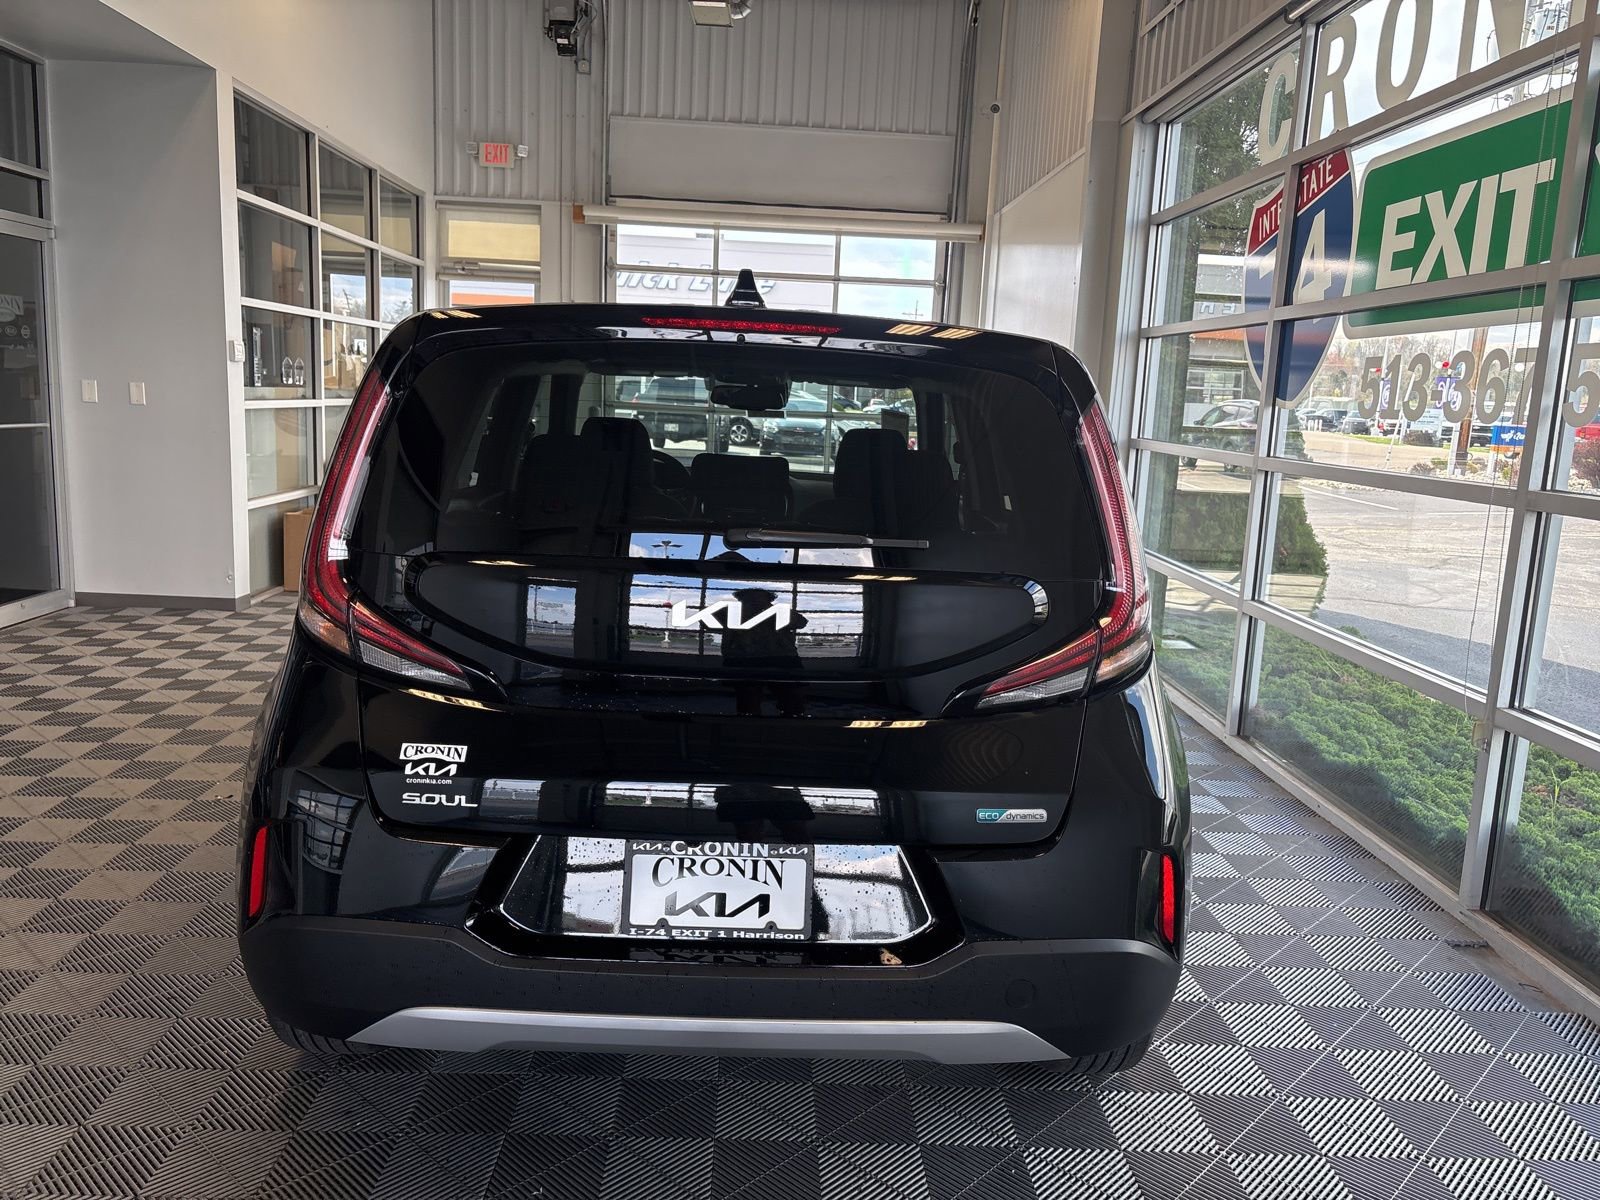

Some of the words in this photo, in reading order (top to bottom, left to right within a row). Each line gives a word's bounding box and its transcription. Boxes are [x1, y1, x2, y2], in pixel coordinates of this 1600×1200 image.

[1258, 0, 1587, 164] CRON
[484, 143, 509, 164] EXIT
[1258, 153, 1334, 242] INTETATE
[1375, 158, 1556, 291] EXIT
[671, 600, 791, 631] KIA
[403, 744, 465, 761] CRONIN
[404, 761, 458, 777] KIA
[406, 777, 453, 785] croninkia.com
[402, 792, 479, 808] SOUL
[978, 812, 1000, 820] ECO
[1005, 812, 1045, 821] dynamics
[632, 842, 663, 851] KIA
[670, 840, 769, 858] CRONIN
[778, 845, 809, 855] KIA
[651, 856, 787, 891] CRONIN
[664, 891, 771, 919] KIA
[629, 927, 667, 937] I-74
[671, 929, 713, 938] EXIT
[717, 930, 727, 938] 1
[732, 930, 805, 940] Harrison
